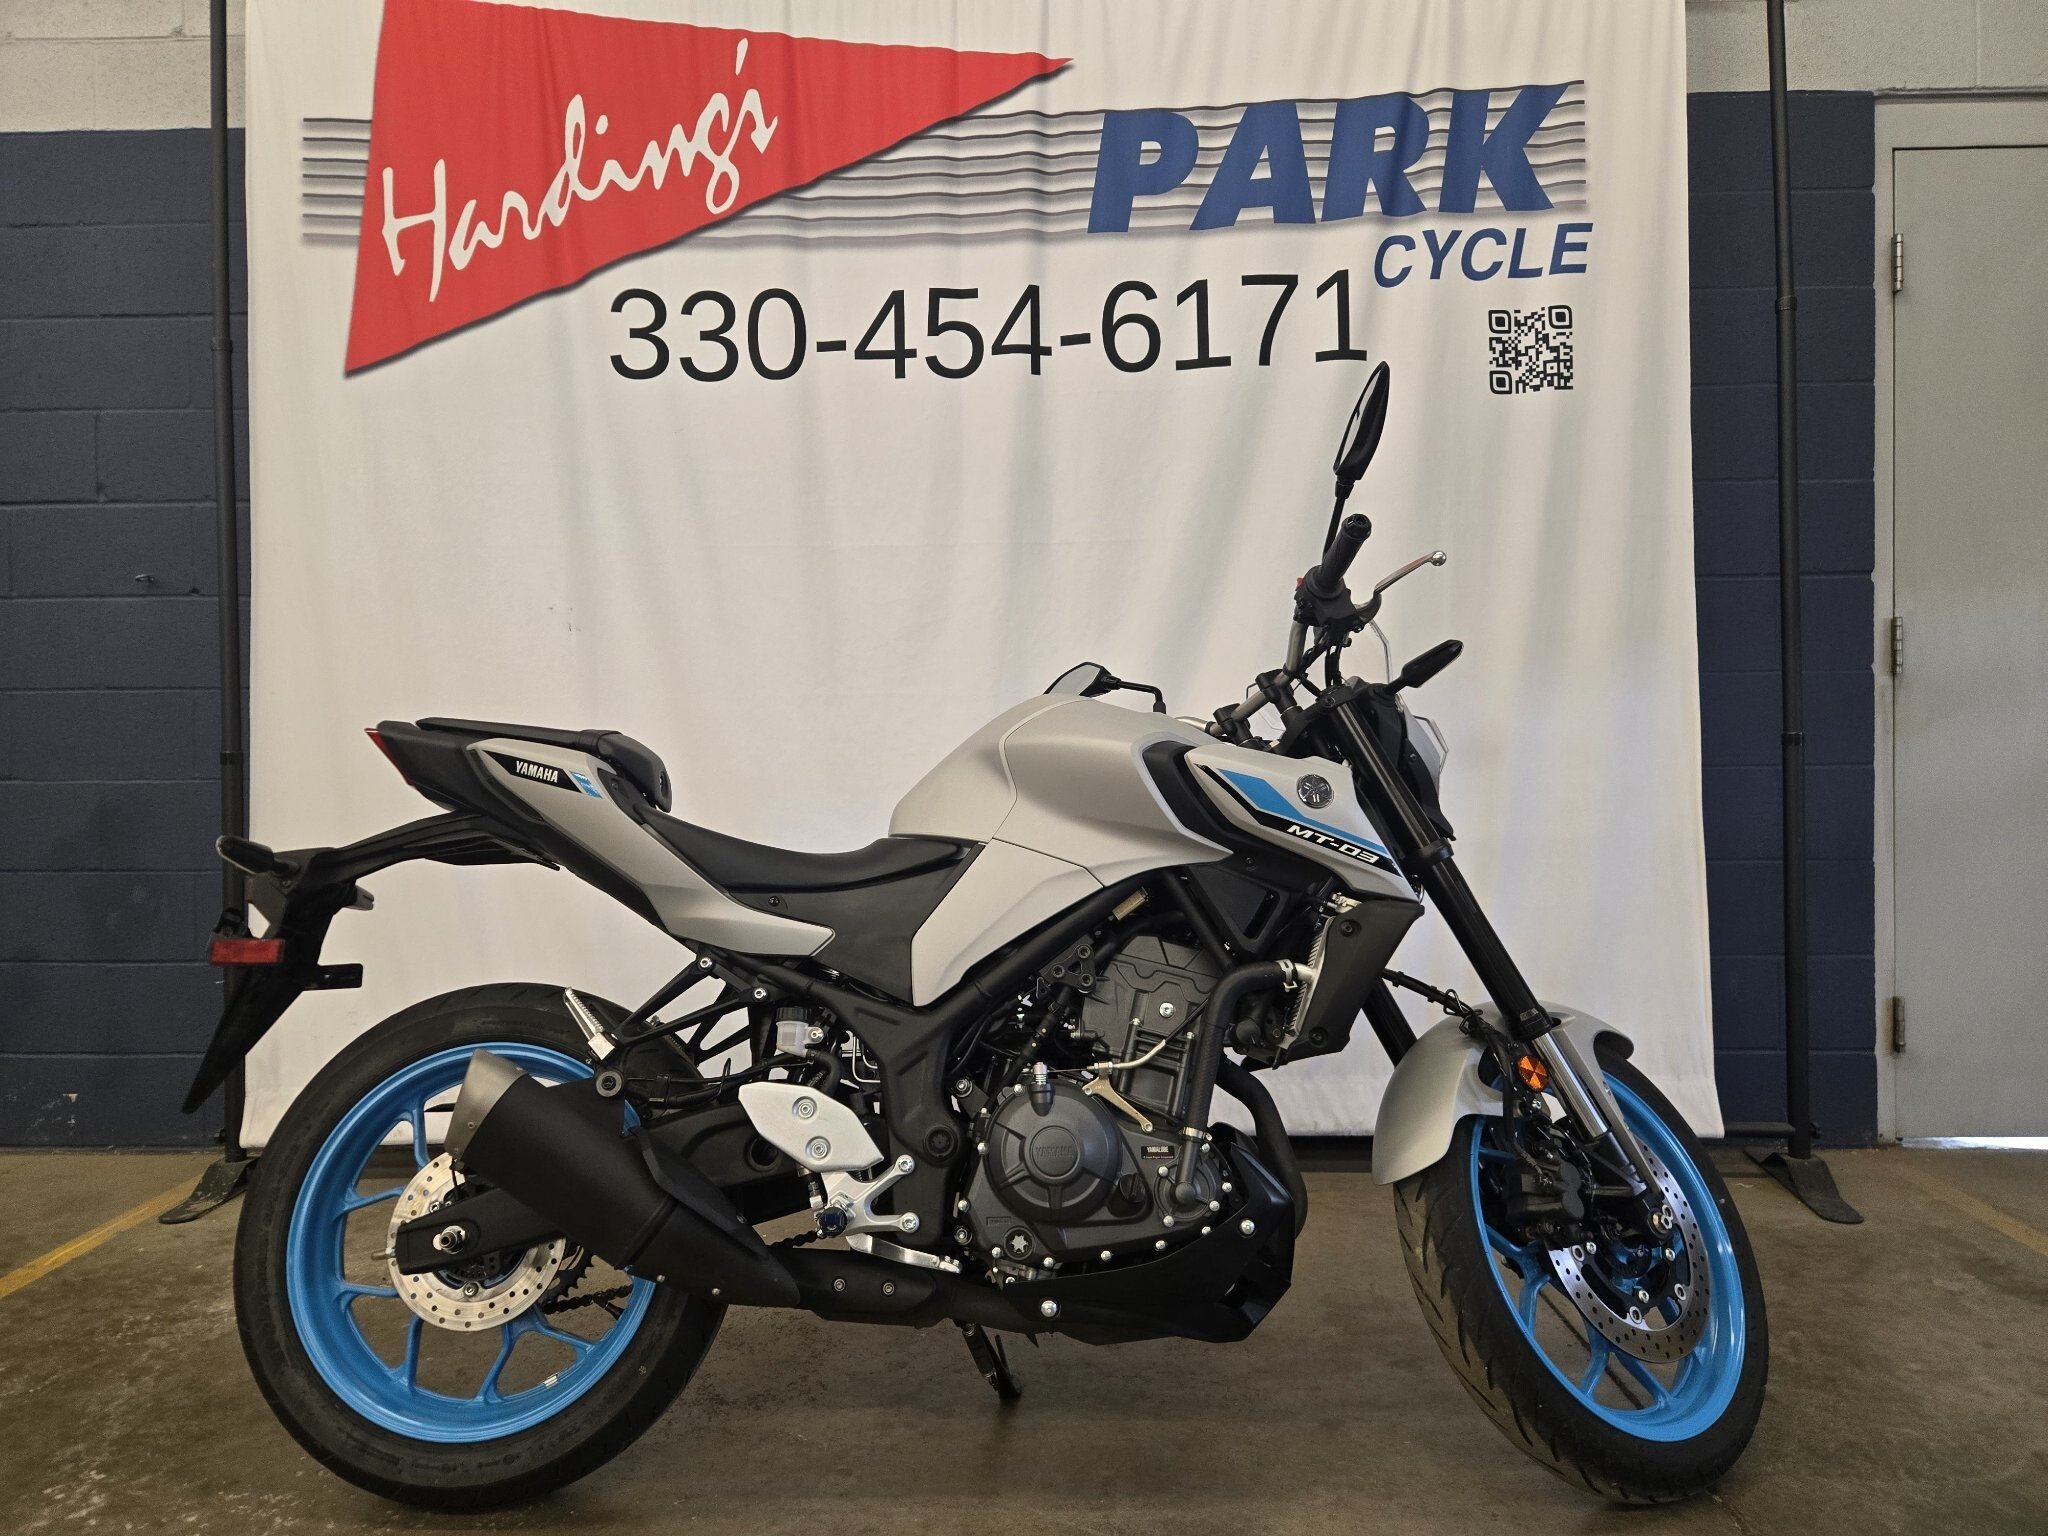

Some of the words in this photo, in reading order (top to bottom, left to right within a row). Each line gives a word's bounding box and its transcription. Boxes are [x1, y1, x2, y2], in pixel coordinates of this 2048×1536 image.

[382, 38, 778, 302] Harding's
[1088, 83, 1569, 233] PARK
[1373, 222, 1594, 288] CYCLE
[610, 269, 1368, 382] 330-454-6171
[515, 760, 559, 783] YAMAHA
[1287, 824, 1380, 864] MT-03
